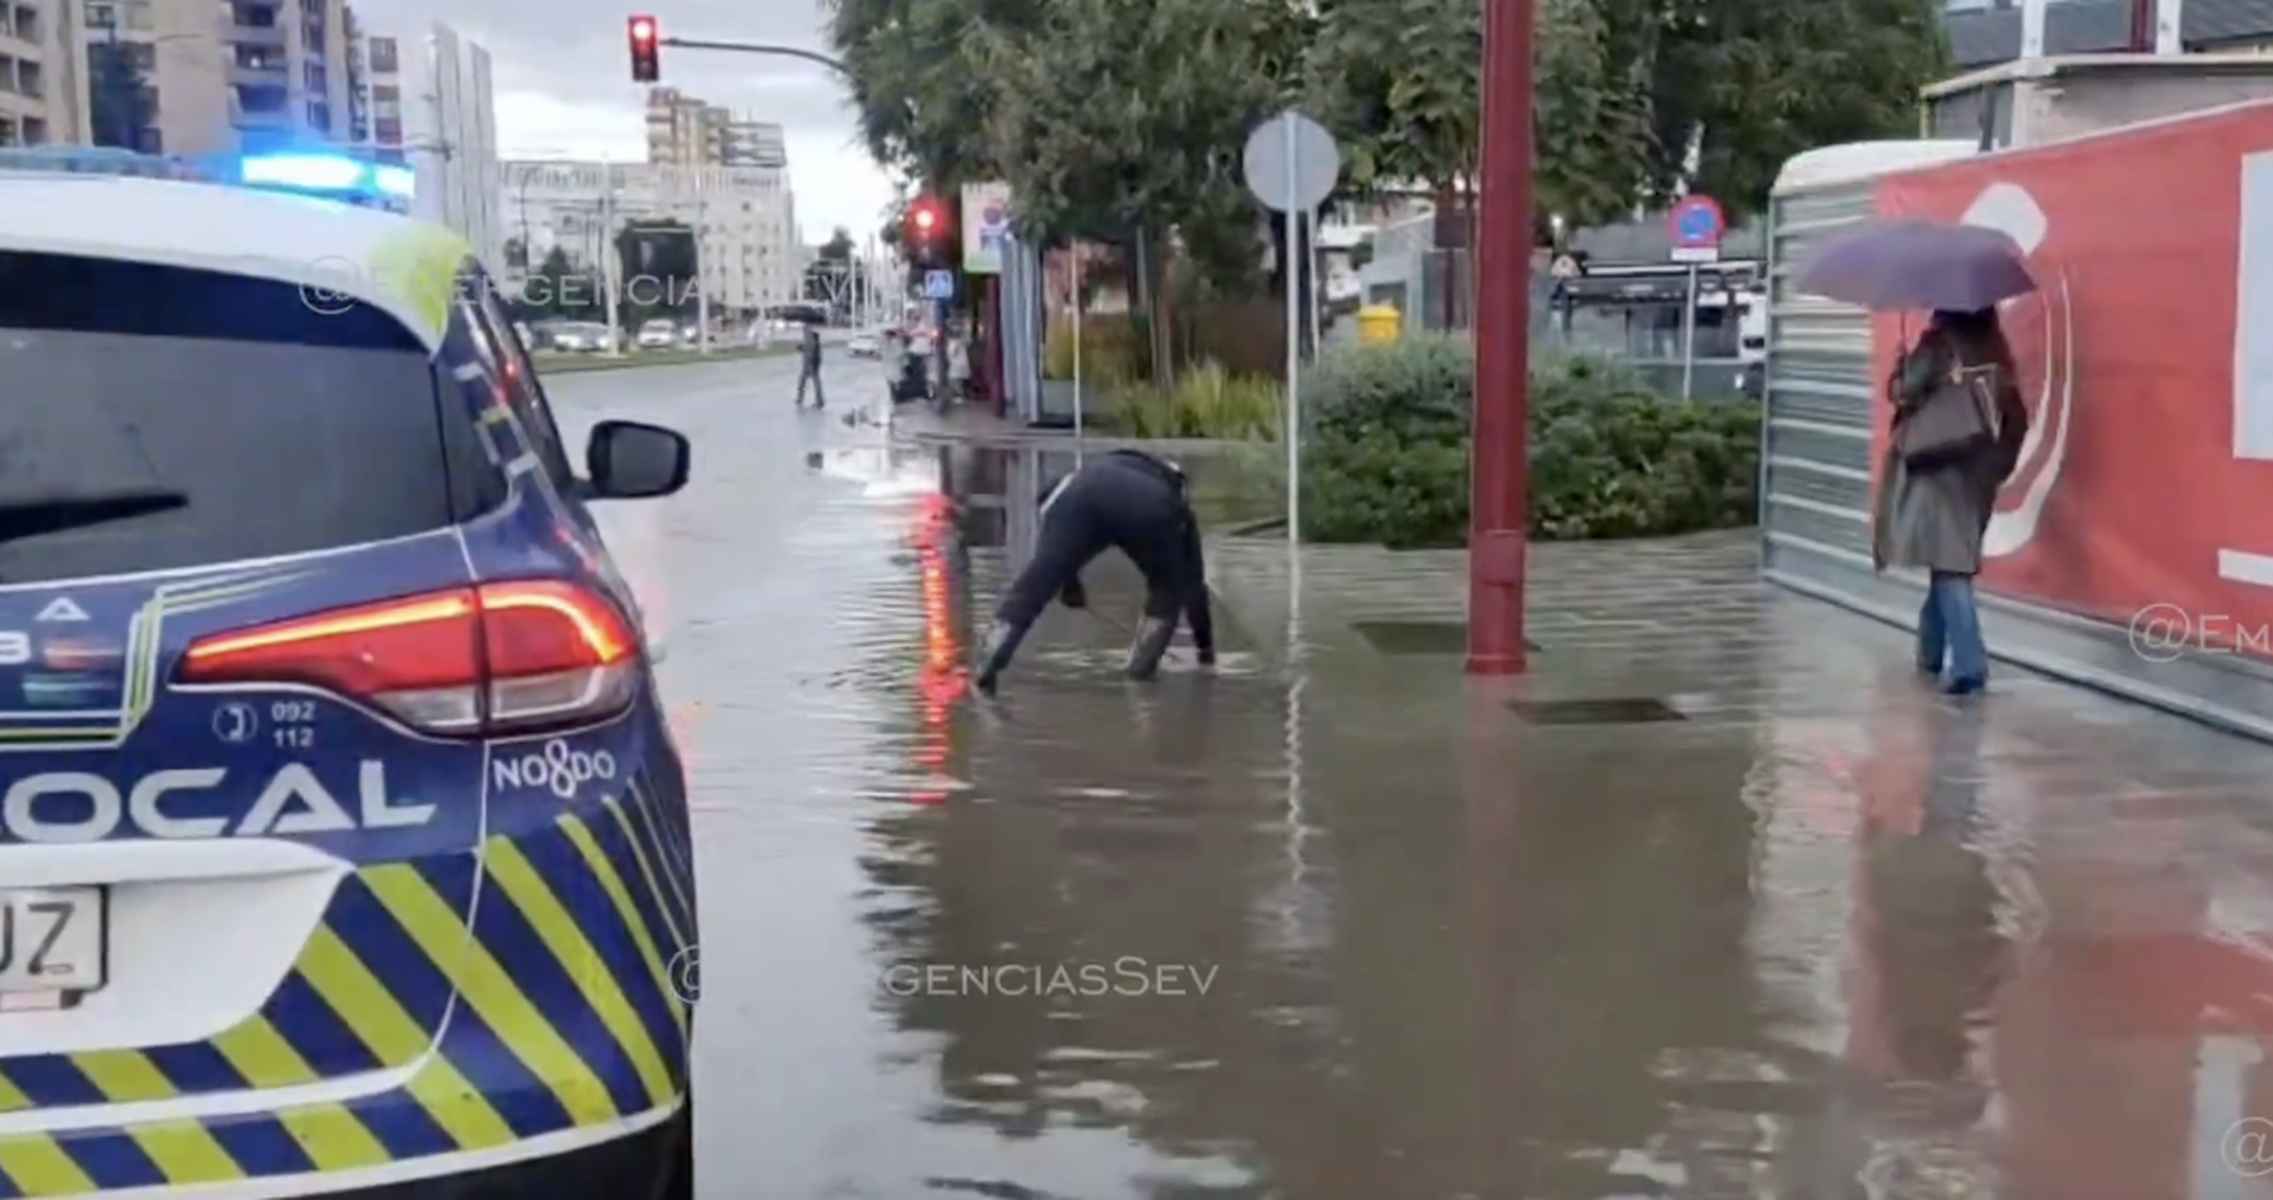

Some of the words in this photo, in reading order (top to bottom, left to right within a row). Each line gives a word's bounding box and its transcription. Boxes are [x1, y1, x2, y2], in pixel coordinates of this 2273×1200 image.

[271, 701, 316, 722] 092
[274, 727, 314, 748] 112
[0, 901, 76, 975] Z
